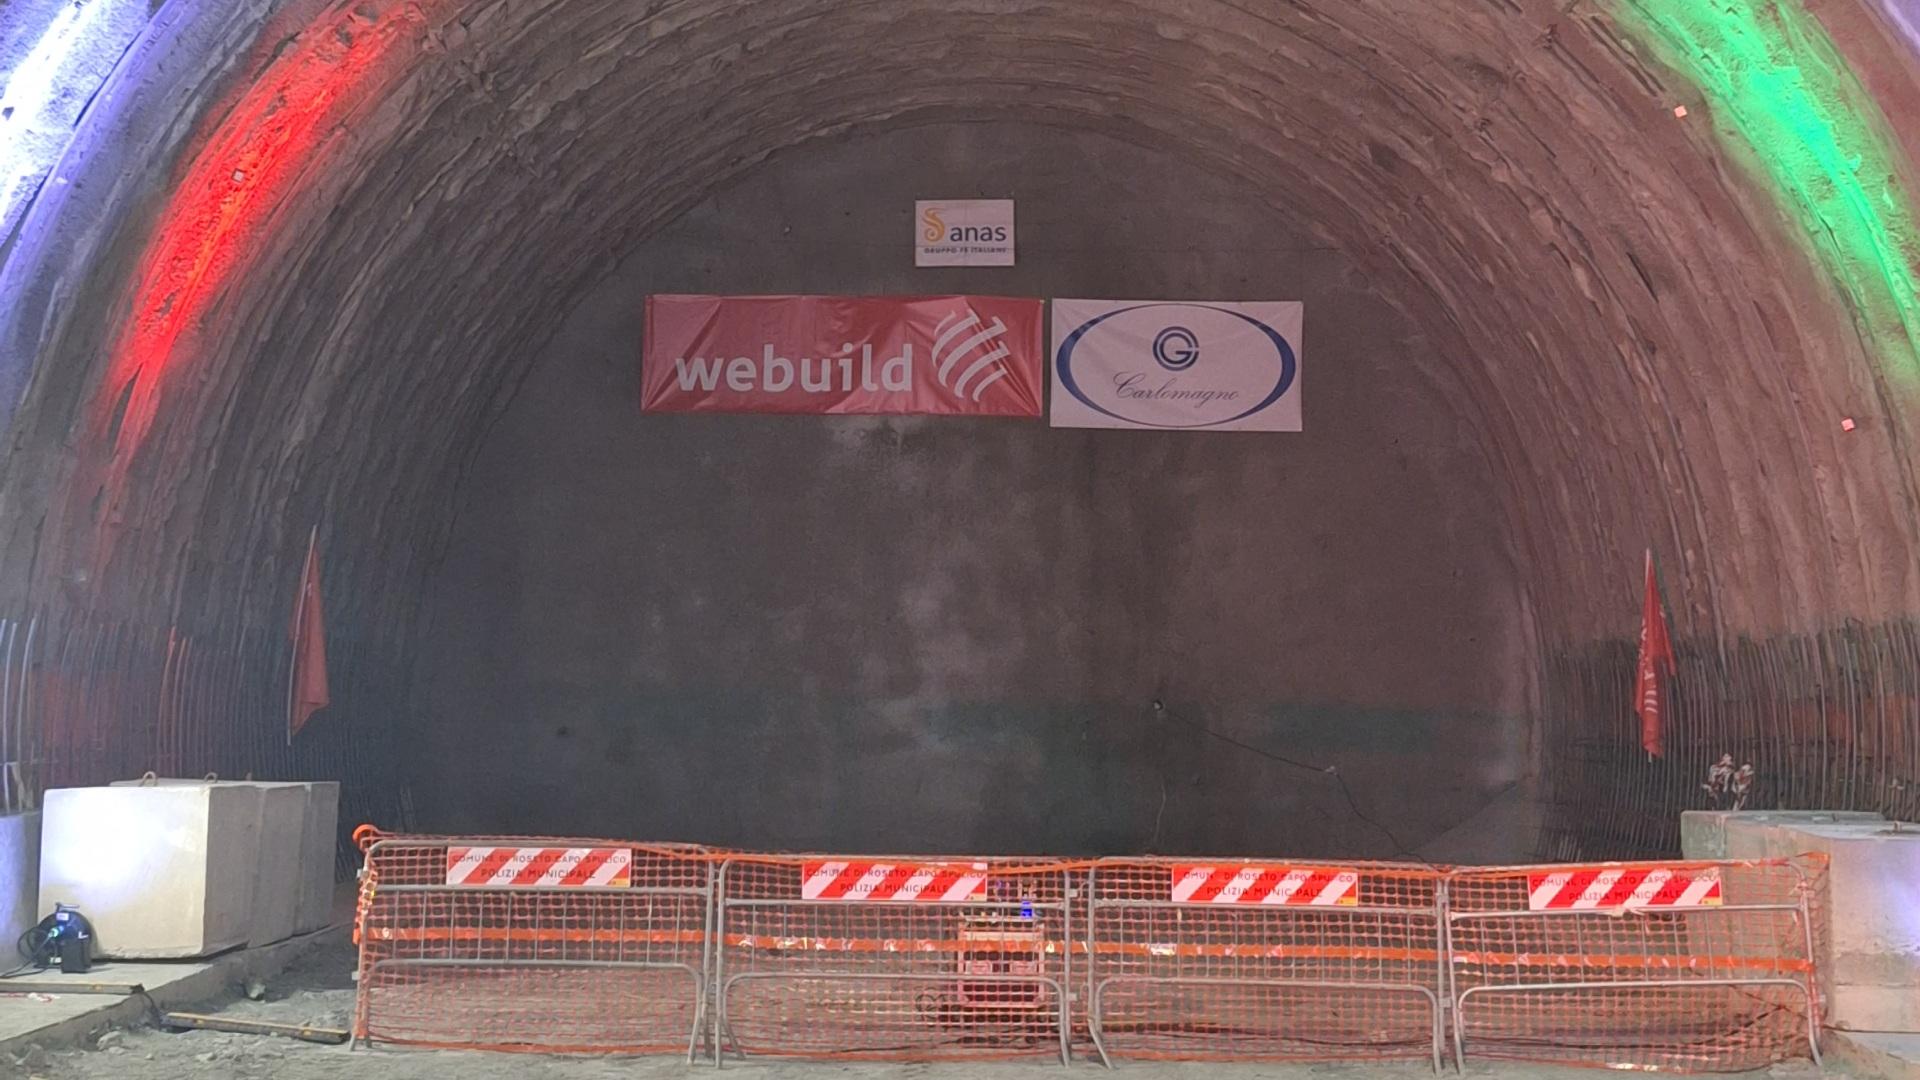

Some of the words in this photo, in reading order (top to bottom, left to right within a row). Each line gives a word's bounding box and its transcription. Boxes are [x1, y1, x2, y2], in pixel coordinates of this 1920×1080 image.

[950, 226, 1007, 242] anas
[675, 343, 913, 392] webuild
[1112, 371, 1239, 409] Carlomagno
[481, 868, 523, 878] POLIZIA
[528, 869, 596, 879] MUNICIPALE
[869, 869, 907, 878] ROSETO
[1238, 872, 1277, 881] ROSETO
[840, 883, 879, 893] POLIZIA
[884, 884, 948, 894] MUNICIPALE
[1206, 887, 1248, 896] POLIZIA
[1254, 887, 1322, 898] MUNICPALE
[1568, 891, 1610, 901] POLIZIA
